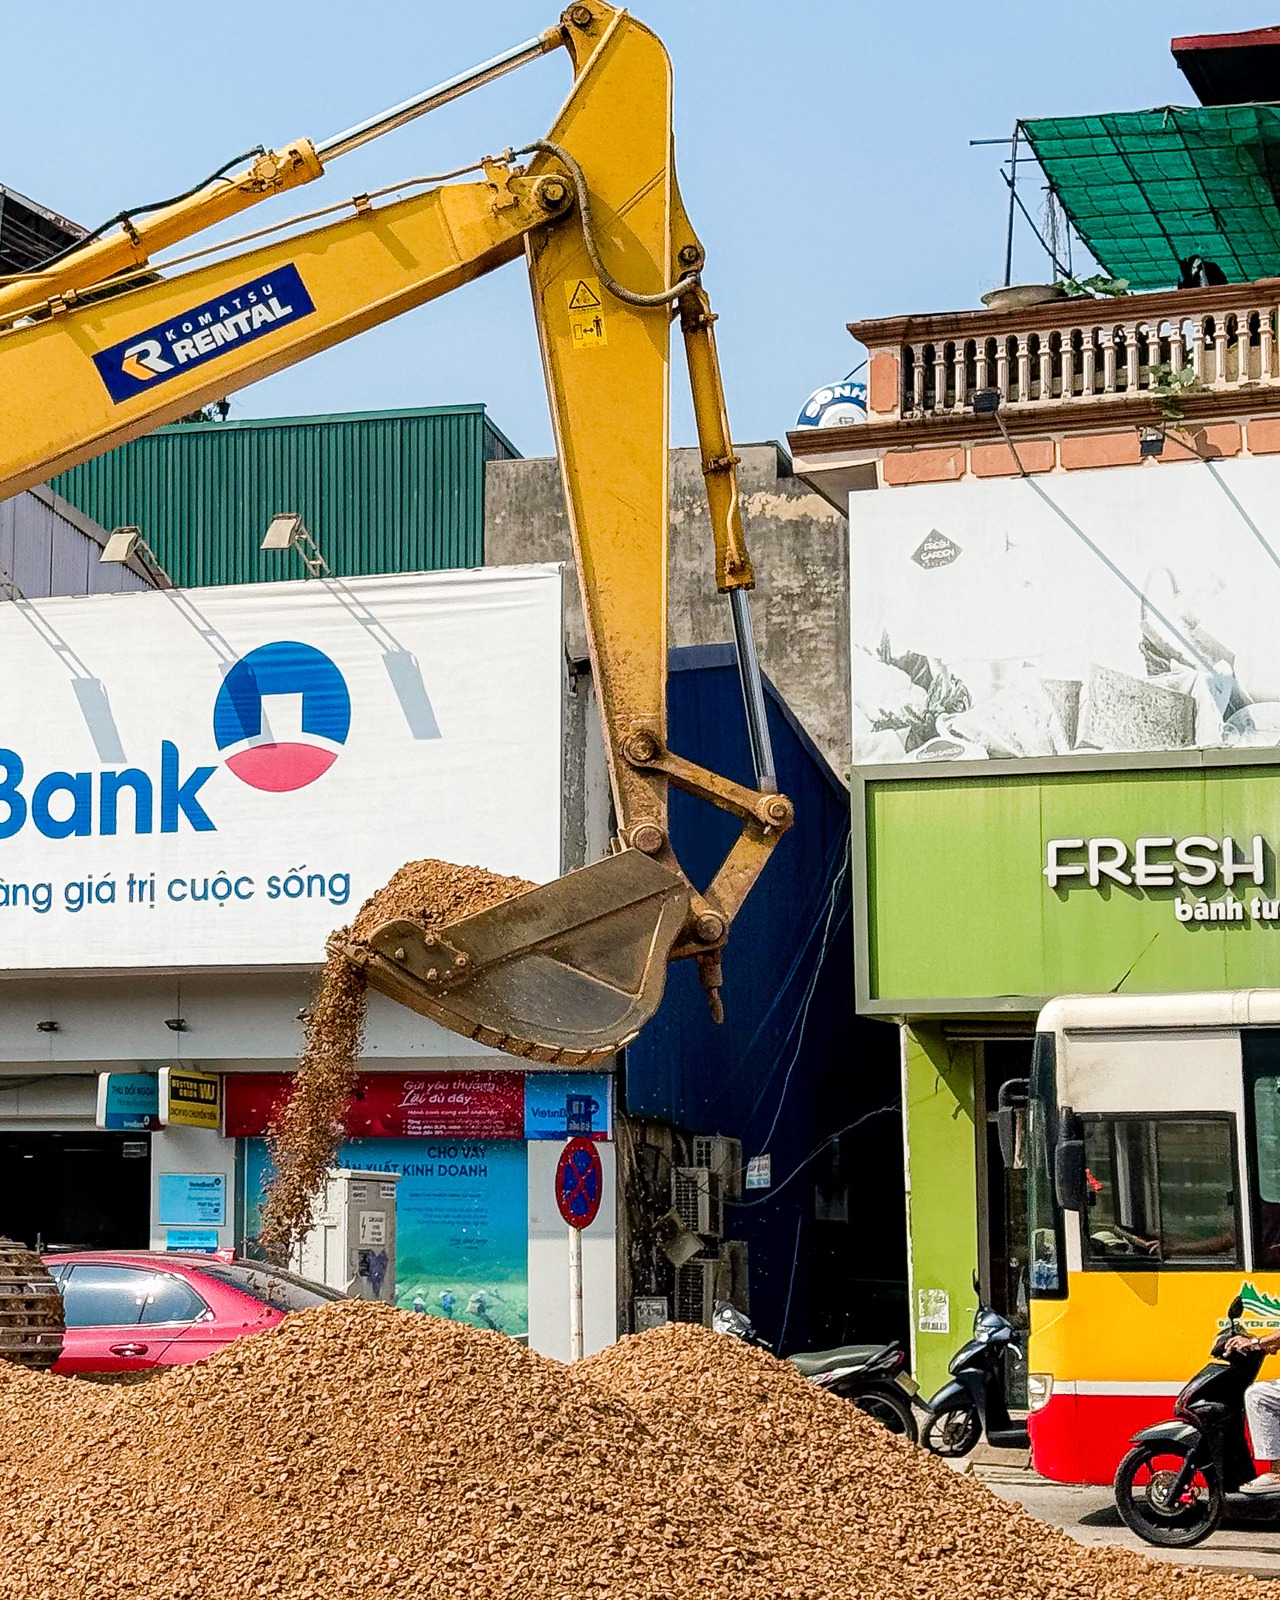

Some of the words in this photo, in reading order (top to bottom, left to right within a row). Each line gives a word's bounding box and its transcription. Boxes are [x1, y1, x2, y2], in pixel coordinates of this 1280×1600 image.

[165, 283, 273, 342] KOMATSU
[172, 297, 293, 365] RENTAL
[1043, 834, 1264, 888] FRESH
[64, 872, 116, 912] giá
[127, 872, 156, 909] trị
[167, 870, 255, 908] cuộc
[266, 865, 350, 905] sống
[1174, 896, 1244, 922] bánh
[531, 1107, 566, 1118] VietinB
[403, 1164, 434, 1177] KINH
[438, 1164, 487, 1177] DOANH
[427, 1146, 458, 1159] CHO
[462, 1146, 487, 1159] VAY
